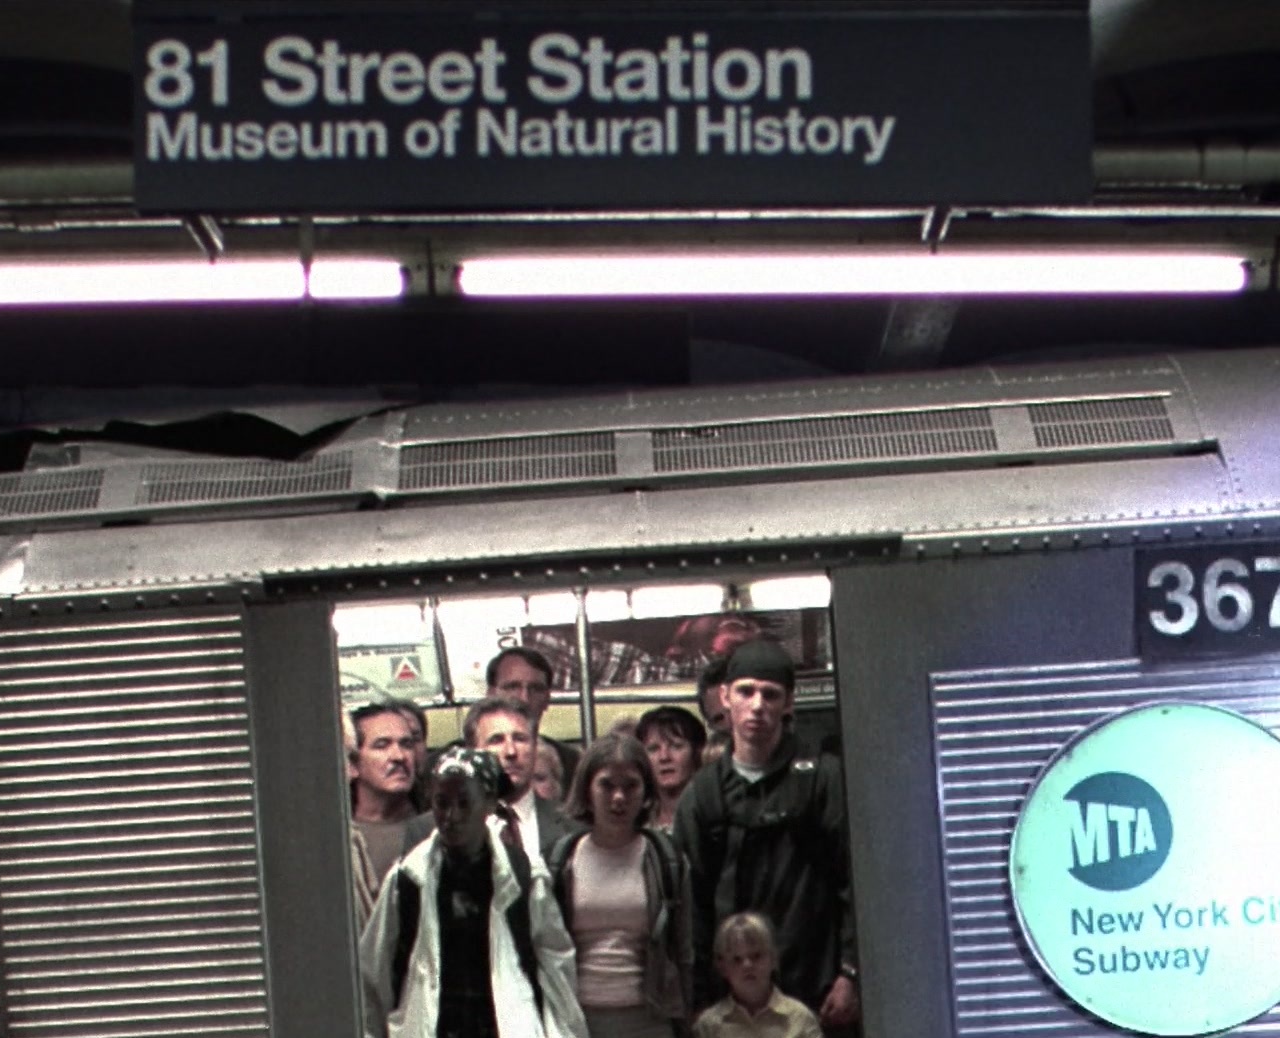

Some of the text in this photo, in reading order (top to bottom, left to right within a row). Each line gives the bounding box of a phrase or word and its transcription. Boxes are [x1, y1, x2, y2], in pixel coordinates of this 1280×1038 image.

[144, 32, 812, 108] 81 Street Station
[146, 106, 895, 164] Museum of Natural History
[1068, 799, 1157, 867] MTA
[1070, 906, 1144, 936] New
[1152, 901, 1229, 931] York
[1072, 945, 1210, 976] Subway
